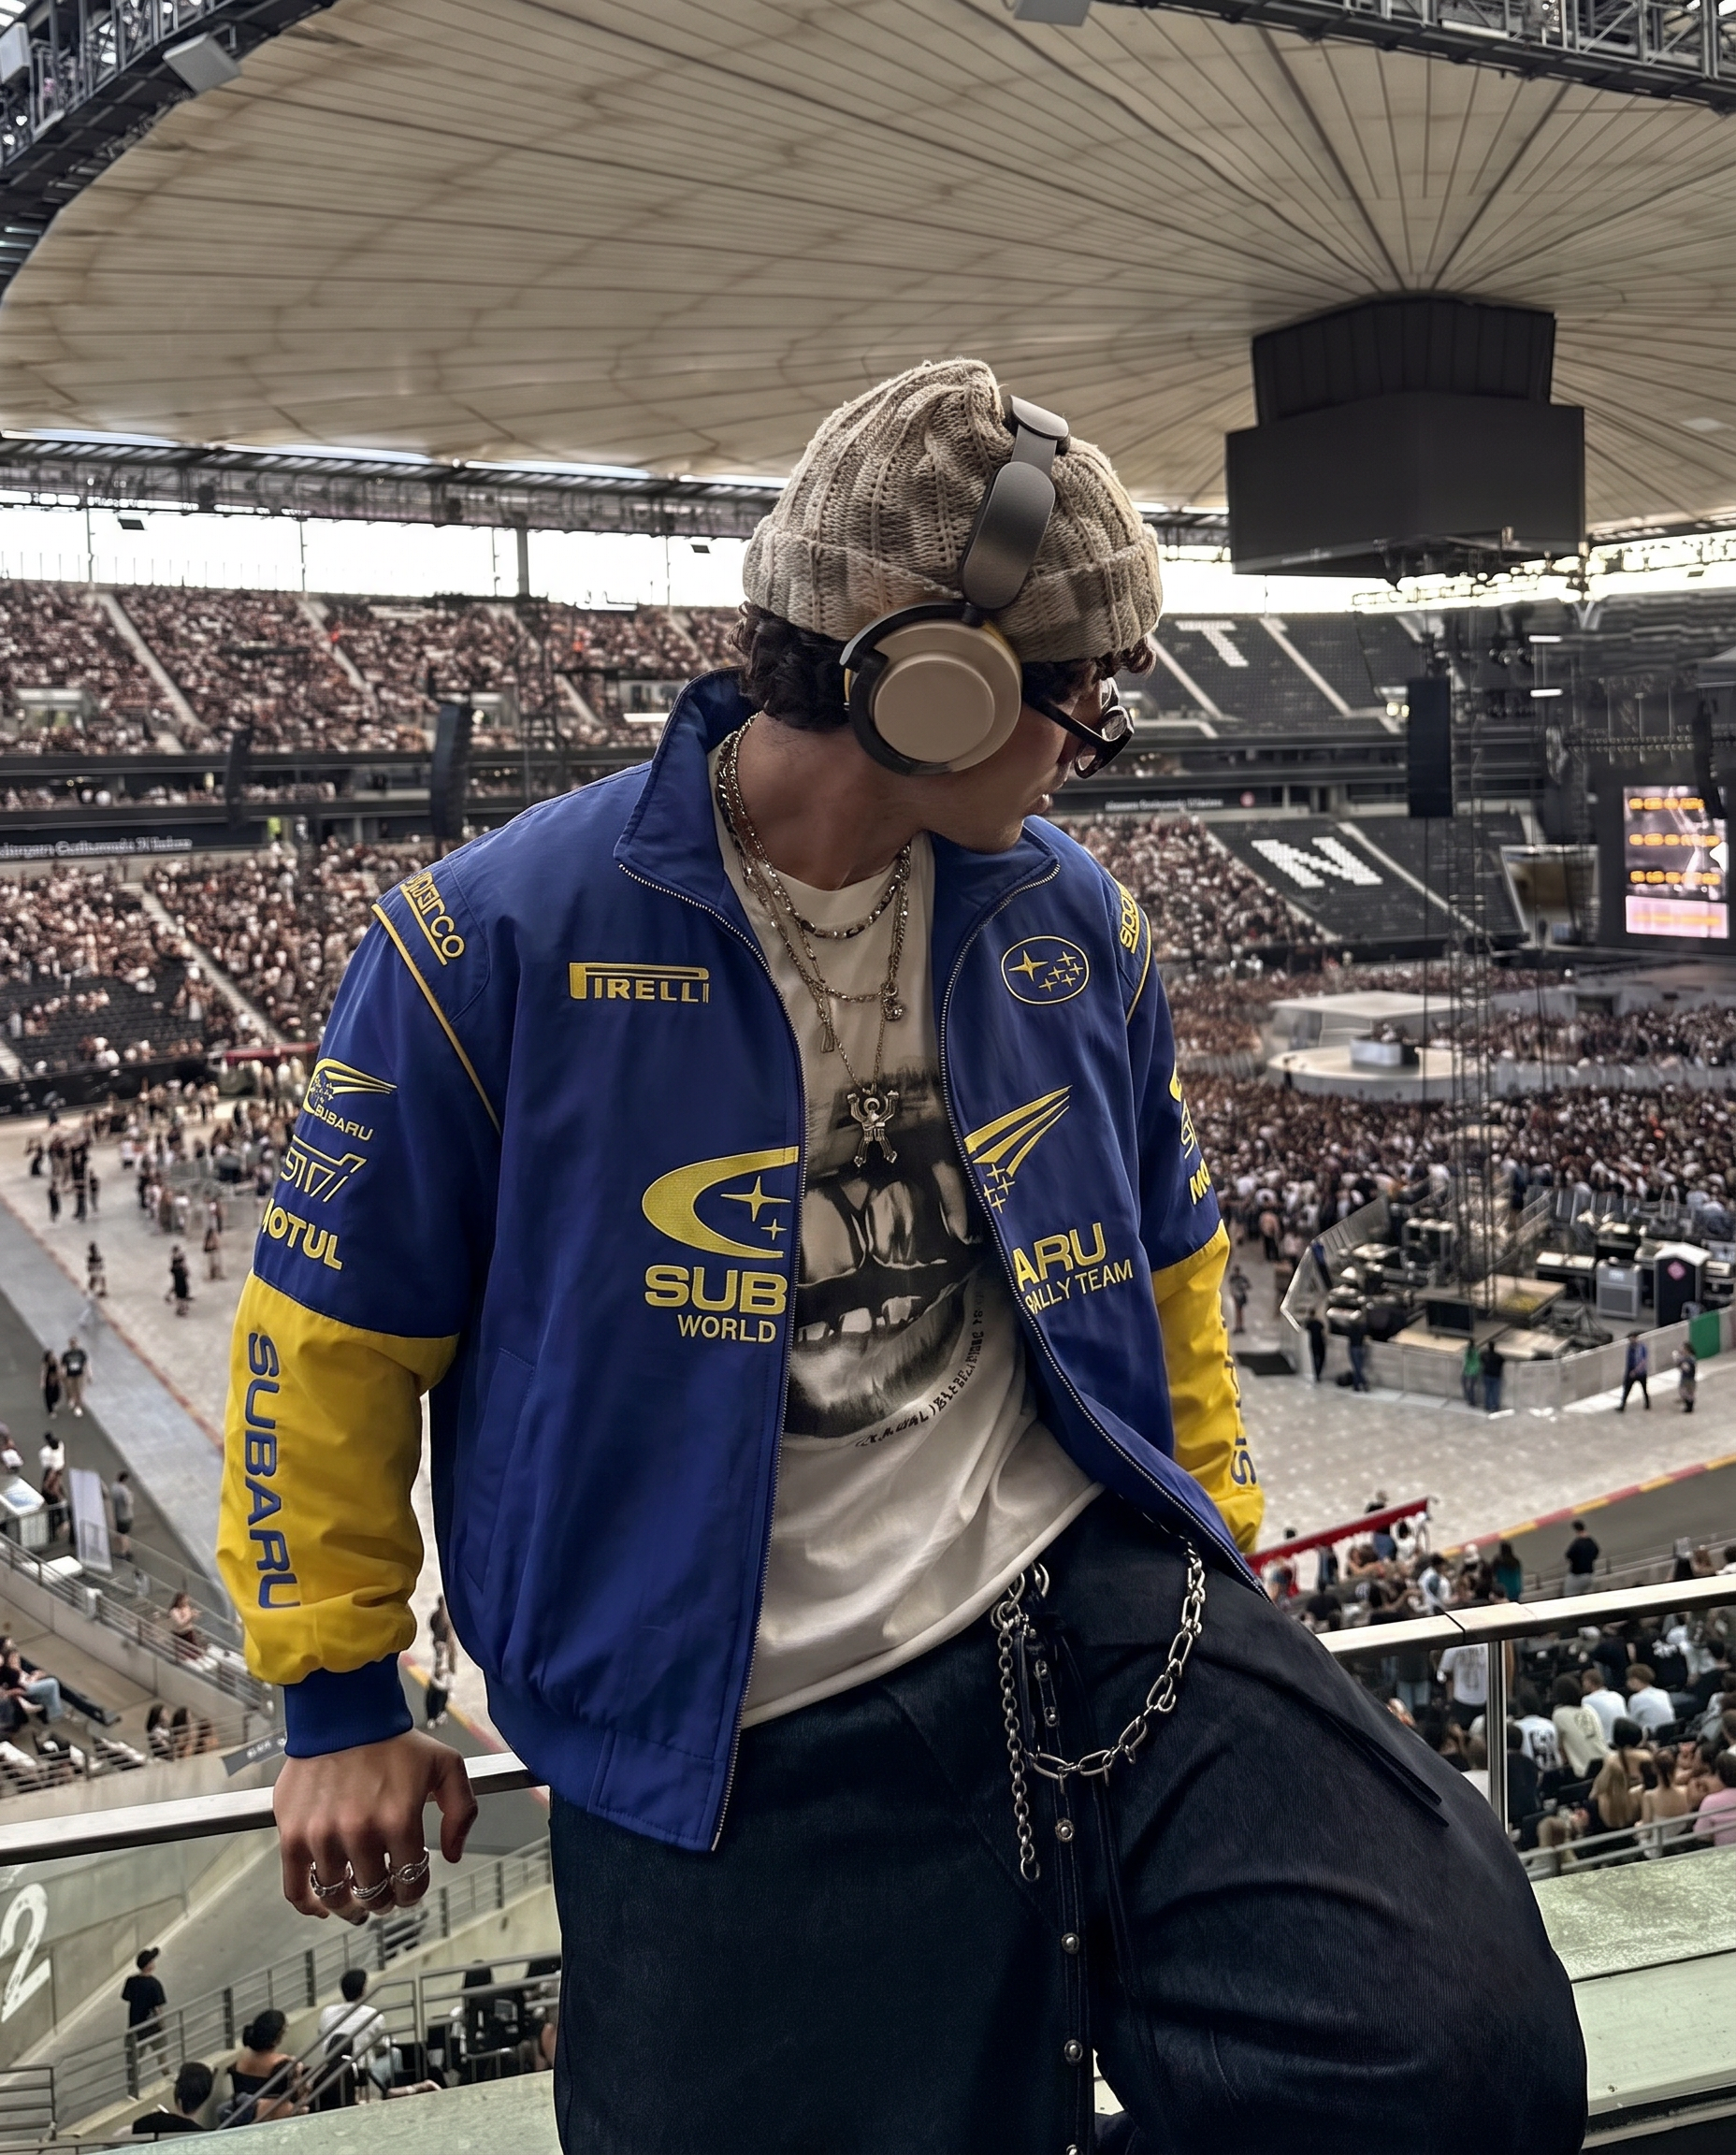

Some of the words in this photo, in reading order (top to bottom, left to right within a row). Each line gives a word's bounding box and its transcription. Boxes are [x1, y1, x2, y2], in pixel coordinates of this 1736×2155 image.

[569, 962, 710, 1003] PIRELLI
[1012, 1222, 1107, 1292] ARU
[1075, 1259, 1134, 1294] TEAM
[644, 1265, 788, 1315] SUB
[677, 1314, 776, 1343] WORLD
[244, 1332, 301, 1609] SUBARU
